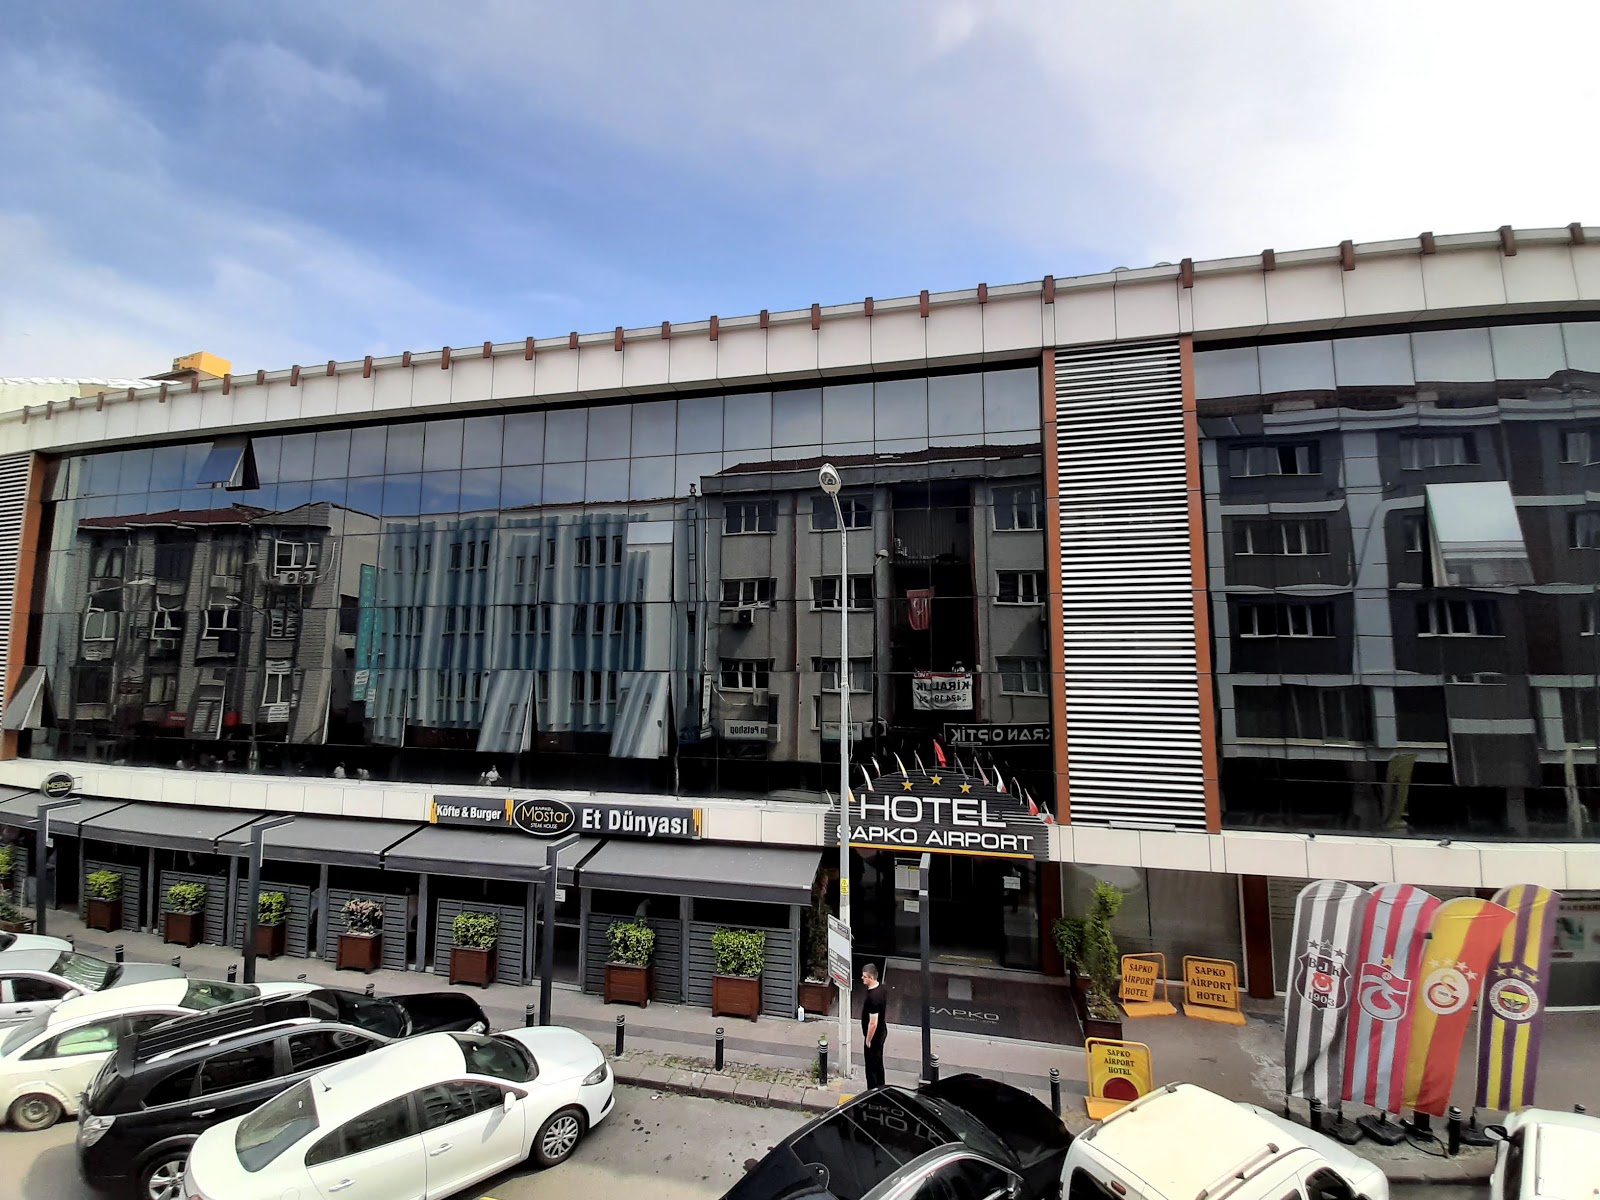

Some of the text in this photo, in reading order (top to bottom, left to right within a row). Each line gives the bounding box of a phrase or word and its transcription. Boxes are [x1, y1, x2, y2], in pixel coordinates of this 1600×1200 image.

[436, 804, 502, 821] Köfte & Burger
[521, 805, 569, 823] Mostar
[860, 794, 1007, 828] HOTEL
[582, 808, 689, 837] Et Dünyası
[925, 829, 1034, 851] AIRPORT
[1128, 963, 1153, 974] SAPKO
[1194, 966, 1226, 978] SAPKO
[1124, 987, 1149, 997] HOTEL
[1196, 990, 1228, 1003] HOTEL
[1308, 991, 1335, 1007] 1903
[1106, 1049, 1131, 1058] SAPKO
[1108, 1066, 1132, 1075] HOTEL
